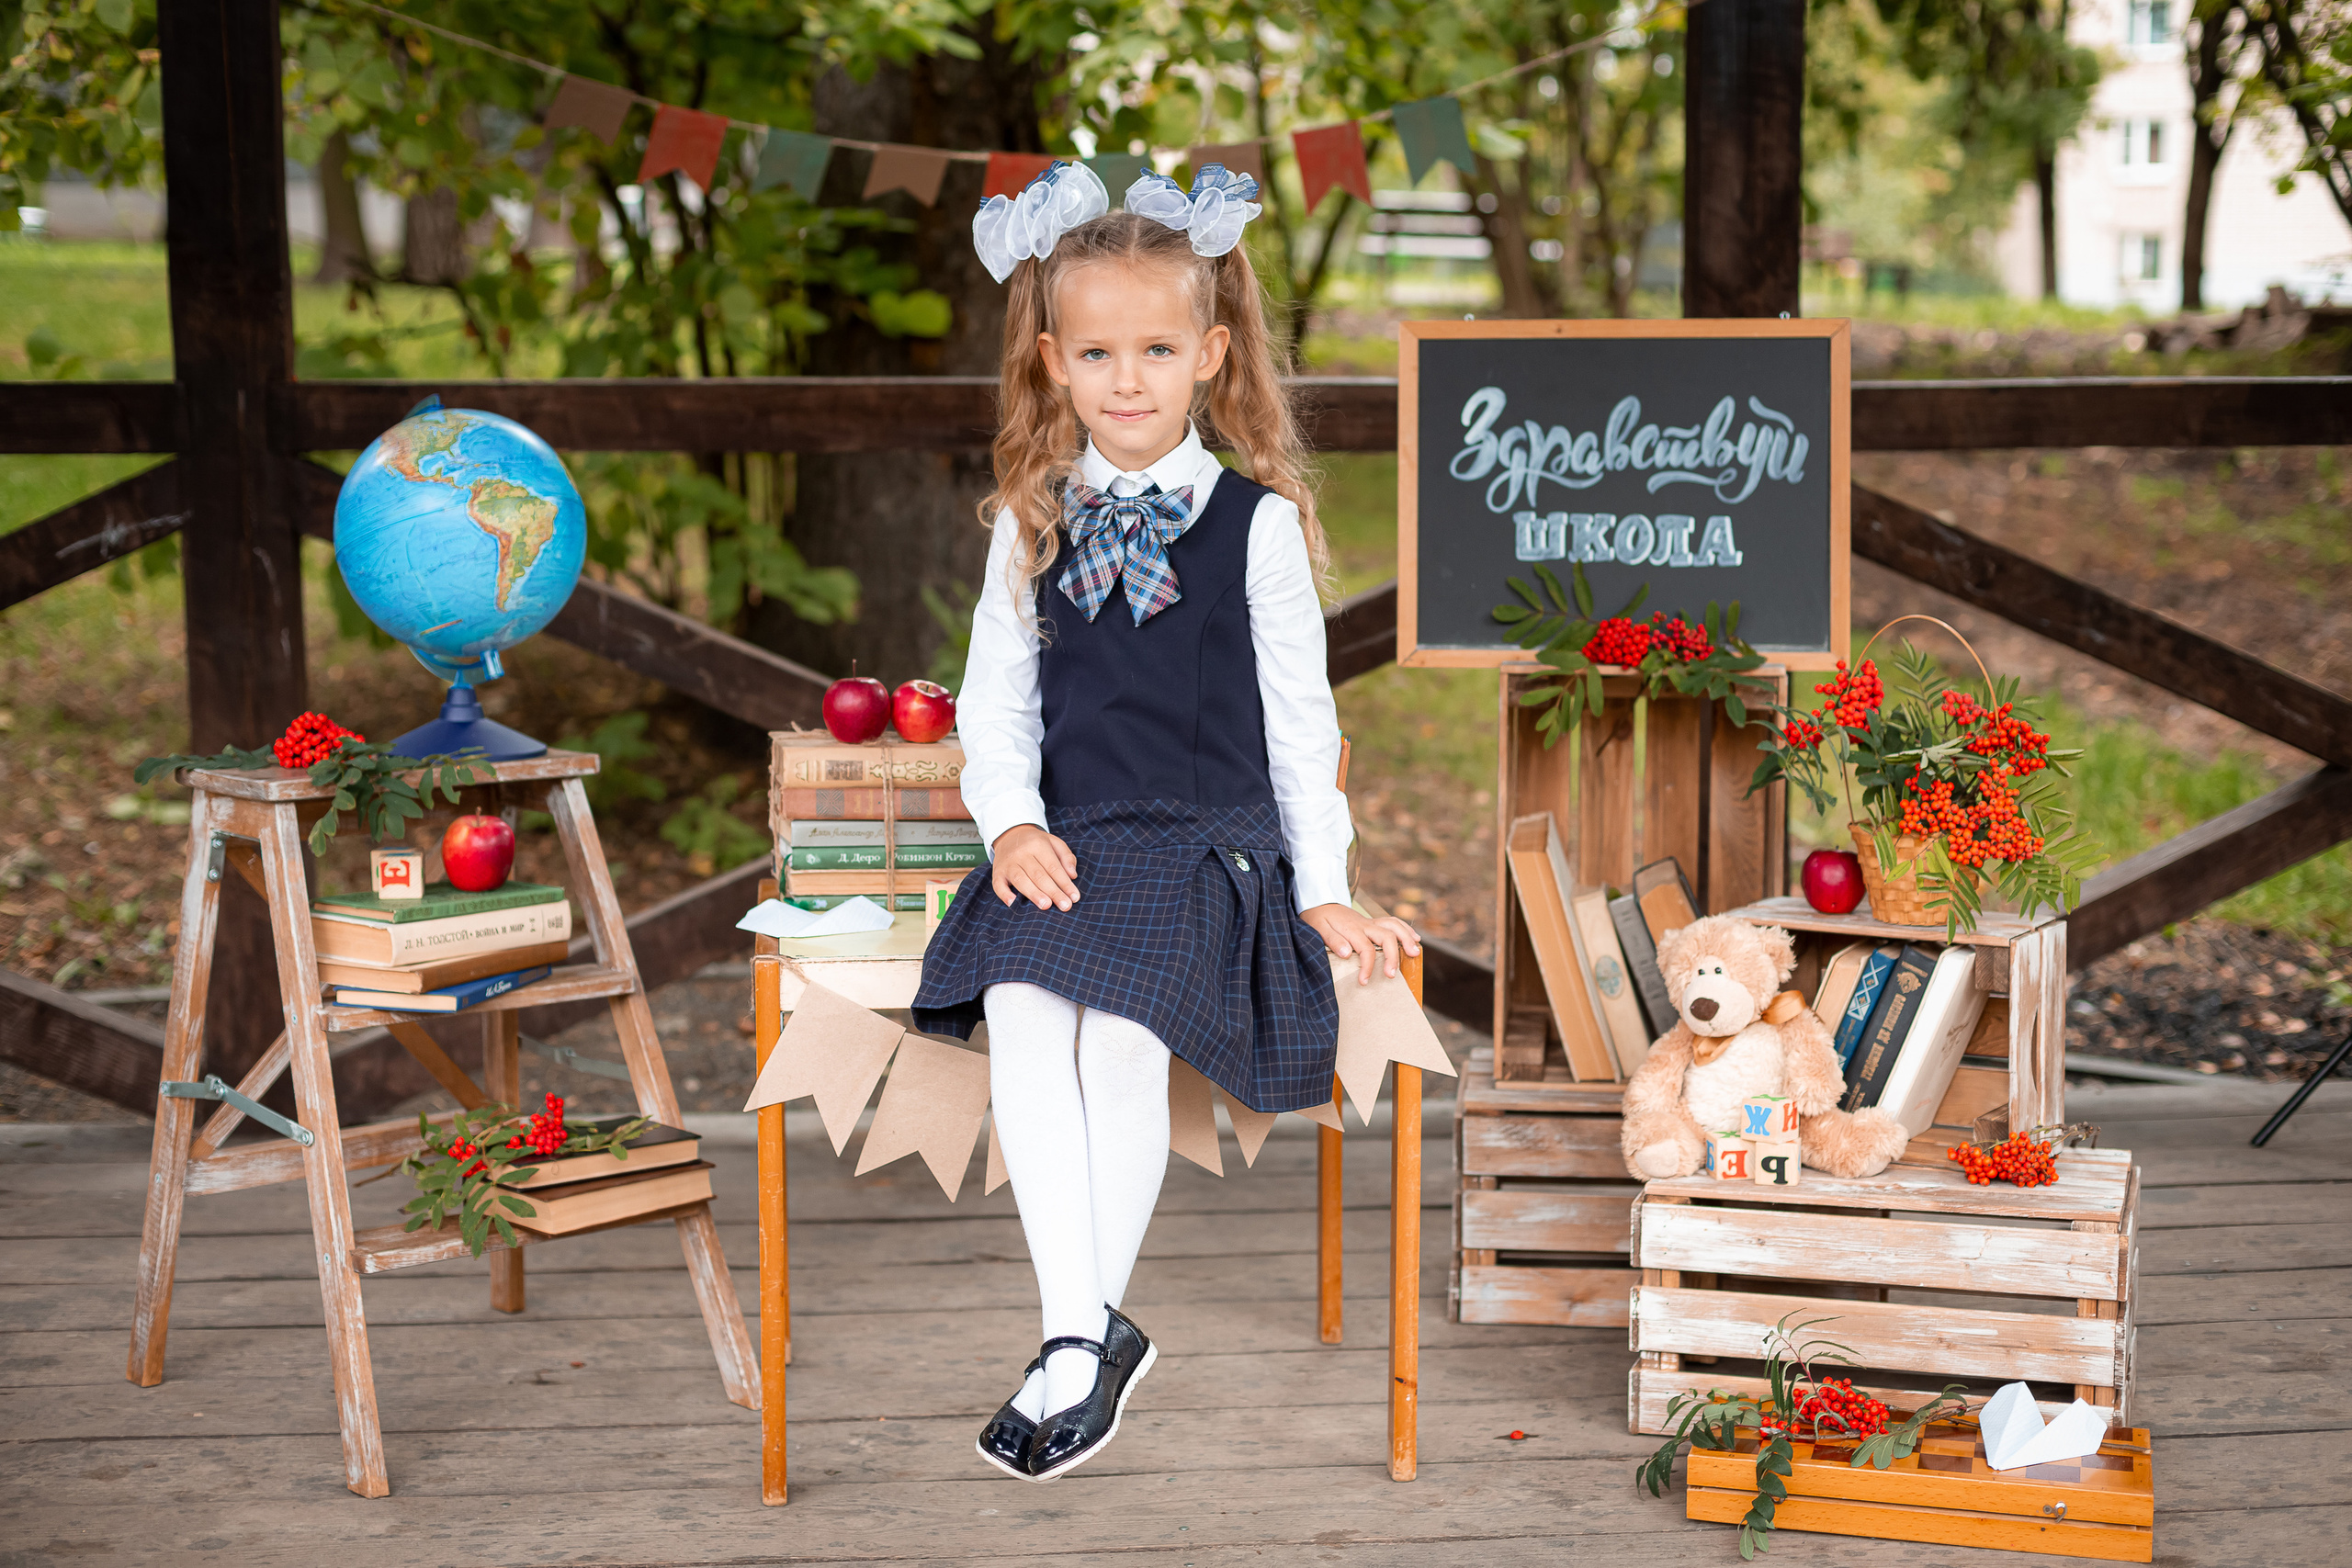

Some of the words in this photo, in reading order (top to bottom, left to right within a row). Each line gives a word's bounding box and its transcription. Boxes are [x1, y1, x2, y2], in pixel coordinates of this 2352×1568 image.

[1450, 386, 1809, 513] Здравствуй
[1512, 511, 1744, 568] ШКОЛА
[851, 852, 881, 864] Дефо
[427, 929, 469, 946] ТОЛСТОЙ
[1744, 1104, 1772, 1136] Ж
